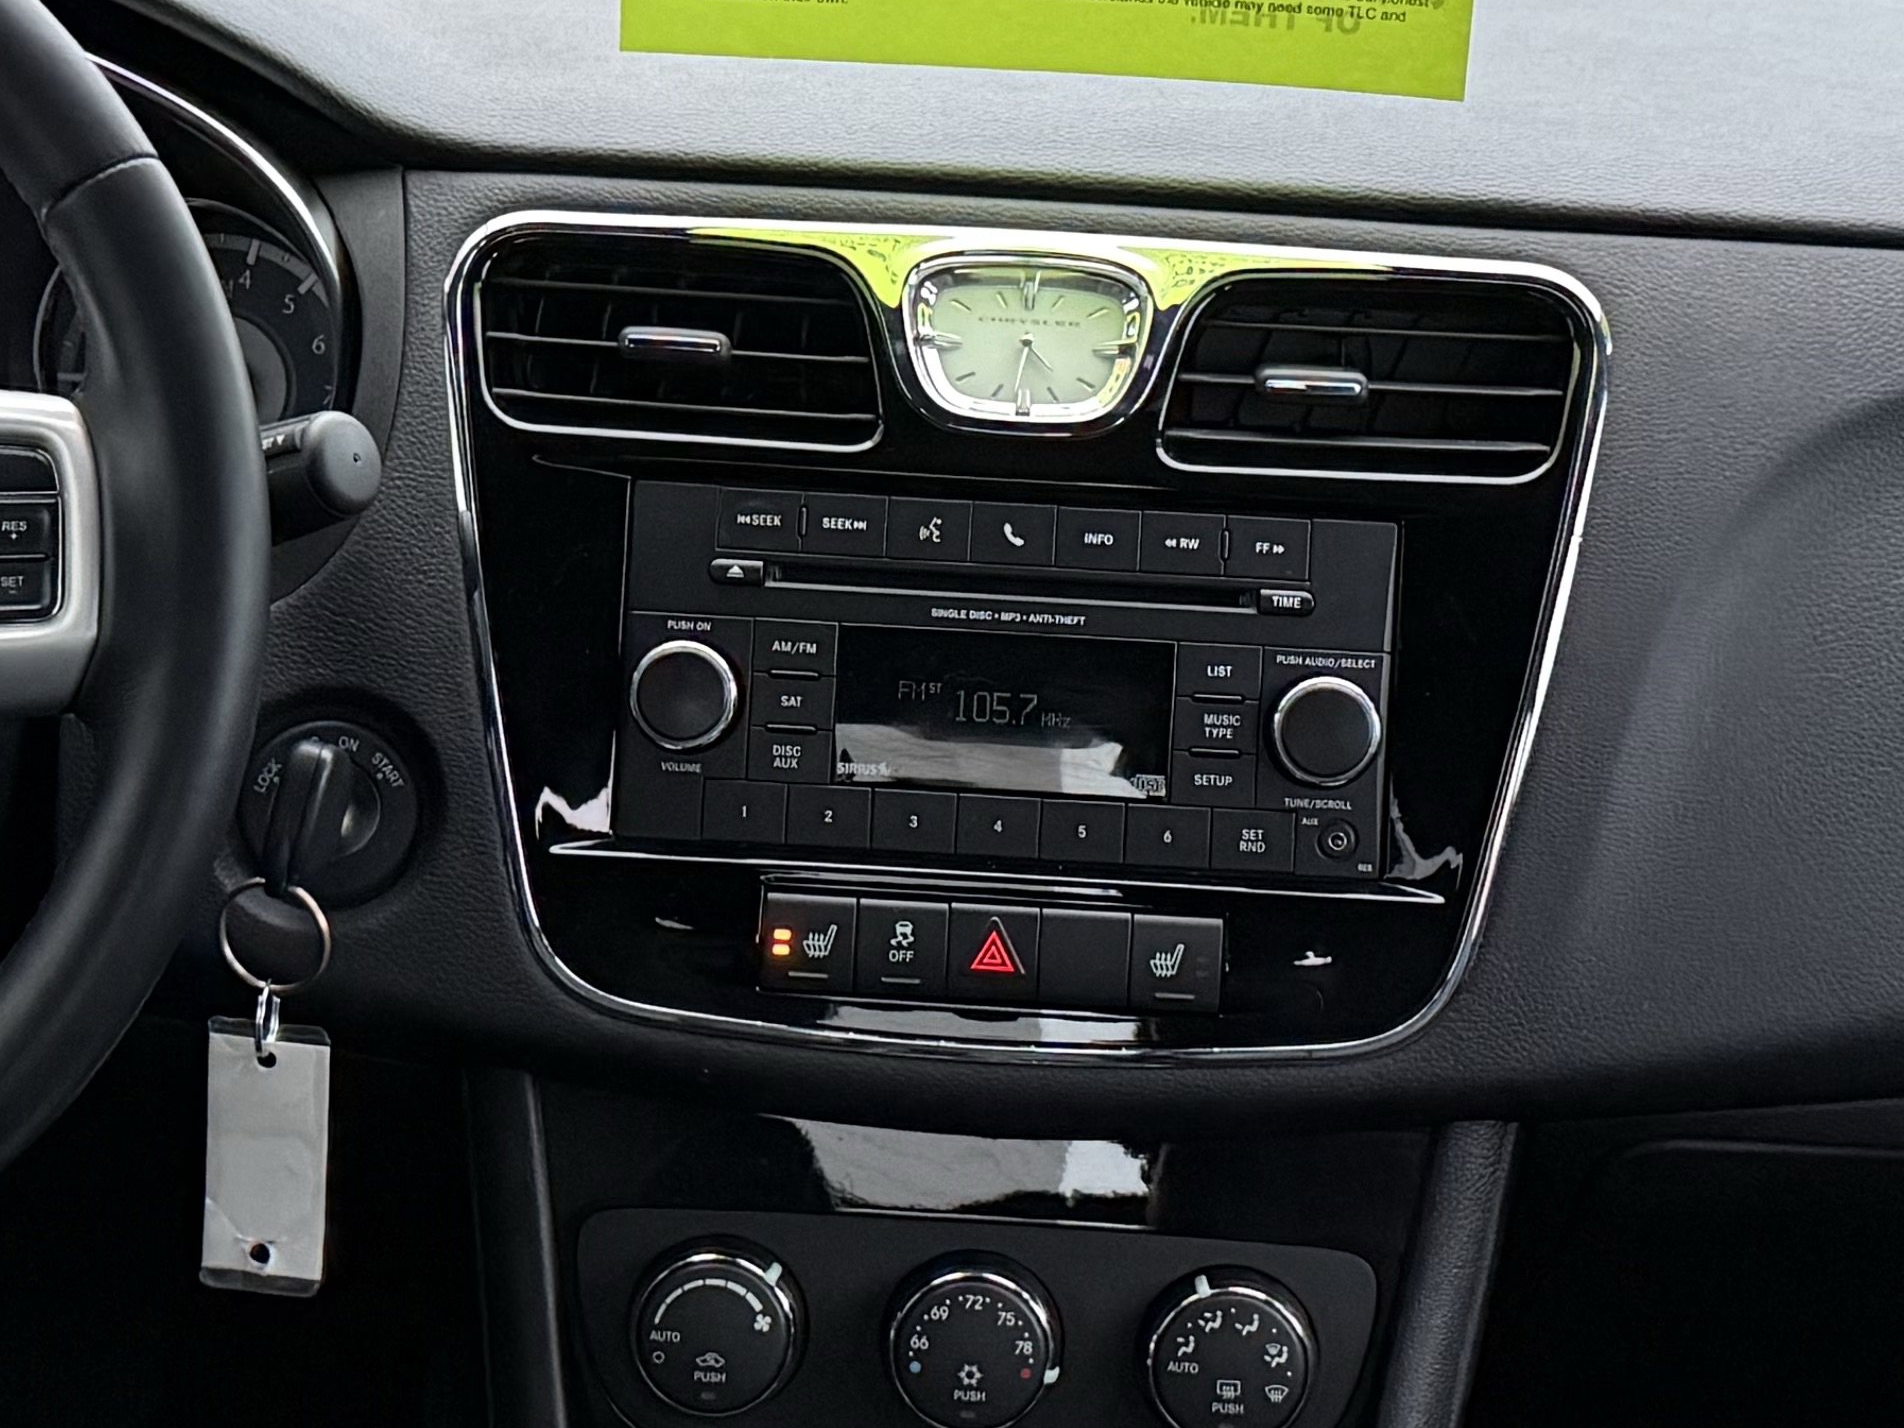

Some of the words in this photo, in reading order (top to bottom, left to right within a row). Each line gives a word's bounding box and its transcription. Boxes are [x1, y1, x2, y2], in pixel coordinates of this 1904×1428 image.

[238, 270, 250, 288] 4
[282, 294, 295, 314] 5
[312, 335, 325, 354] 6
[2, 521, 27, 531] RES
[752, 515, 781, 526] SEEK
[823, 518, 852, 530] SEEK
[1084, 533, 1113, 545] INFO
[1180, 538, 1199, 549] RW
[1256, 543, 1270, 554] FF
[0, 576, 23, 587] SET
[1272, 596, 1301, 608] TIME
[932, 608, 967, 619] SINGLE
[970, 610, 992, 620] DISC
[1001, 612, 1020, 621] MP3
[1029, 614, 1085, 625] ANTI-THEFT
[668, 620, 694, 630] PUSH
[696, 622, 711, 631] ON
[772, 641, 817, 654] AM/FM
[1277, 655, 1302, 664] PUSH
[1304, 657, 1376, 668] AUDIO/SELECT
[1207, 666, 1232, 677] LIST
[781, 696, 802, 707] SAT
[955, 690, 1037, 725] 105.7
[1204, 714, 1241, 726] MUSIC
[1205, 728, 1233, 739] TYPE
[338, 736, 360, 752] ON
[773, 745, 801, 757] DISC
[661, 762, 702, 772] VOLUME
[773, 758, 798, 768] AUX
[371, 752, 404, 788] START
[253, 759, 283, 794] LOCK
[1194, 775, 1232, 786] SETUP
[1284, 798, 1351, 810] TUNE/SCROLL
[742, 805, 746, 817] 1
[825, 811, 832, 822] 2
[910, 816, 918, 828] 3
[994, 821, 1002, 833] 4
[1078, 826, 1086, 838] 5
[1164, 831, 1172, 843] 6
[1242, 830, 1263, 840] SET
[1239, 842, 1265, 853] RND
[889, 949, 914, 963] OFF
[965, 1295, 983, 1310] 72
[930, 1306, 949, 1321] 69
[997, 1312, 1016, 1326] 75
[650, 1332, 681, 1342] AUTO
[910, 1336, 929, 1350] 66
[1015, 1341, 1033, 1355] 78
[1167, 1361, 1199, 1374] AUTO
[694, 1372, 725, 1382] PUSH
[953, 1390, 986, 1401] PUSH
[1212, 1403, 1243, 1414] PUSH
